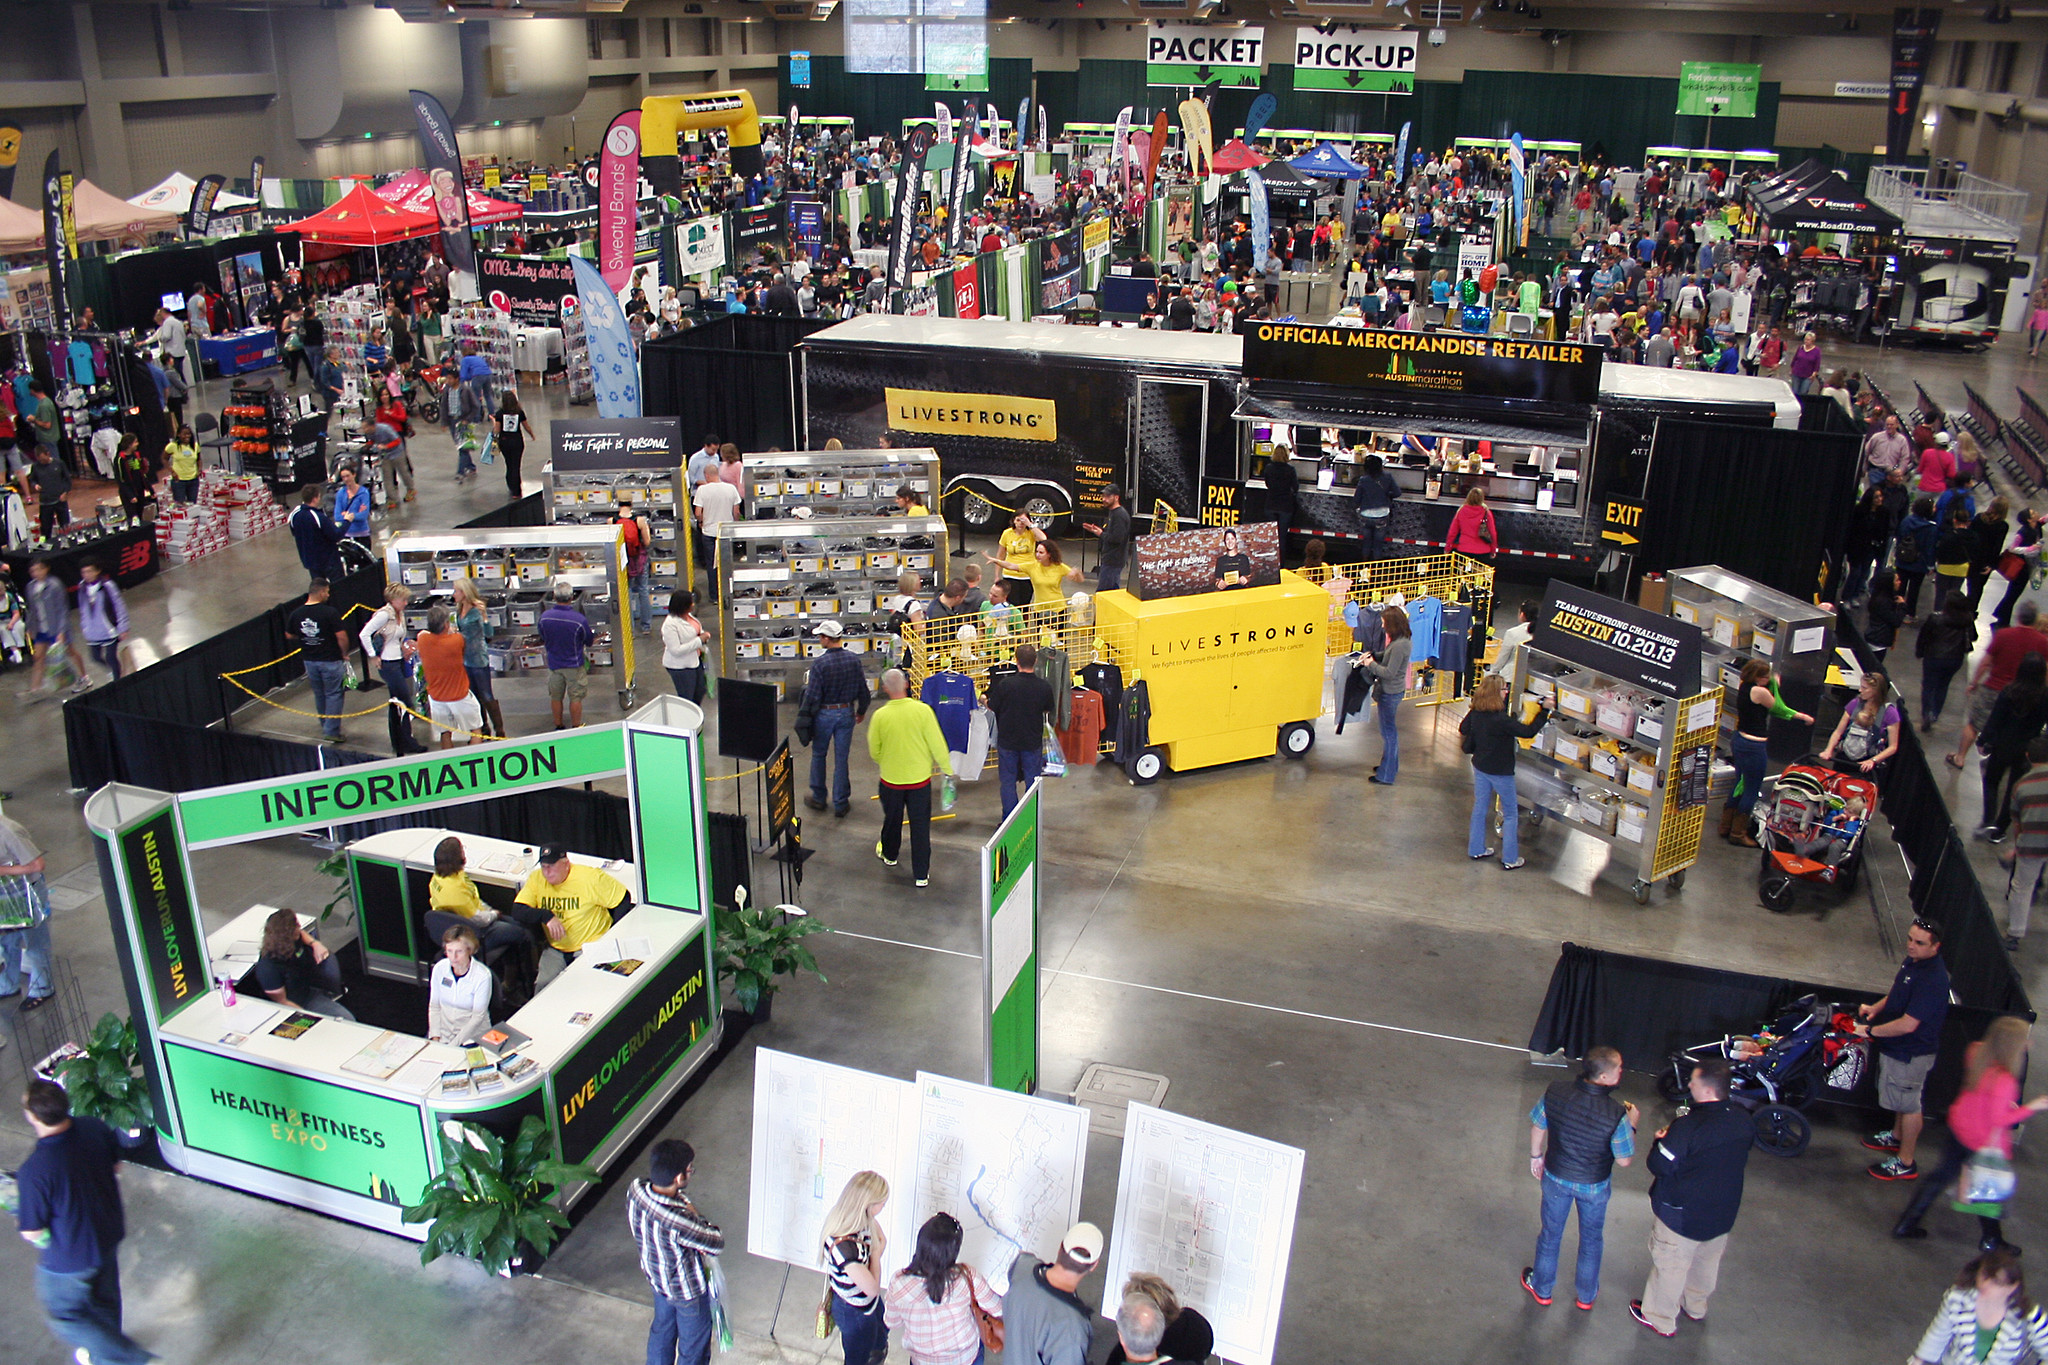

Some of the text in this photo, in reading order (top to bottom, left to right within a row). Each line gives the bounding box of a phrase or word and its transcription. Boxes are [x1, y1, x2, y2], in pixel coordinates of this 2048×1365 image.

[1149, 37, 1261, 63] PACKET
[1298, 42, 1415, 69] PICK-UP
[608, 163, 627, 270] Bands Sweaty
[1796, 221, 1876, 232] www.RoadID.com
[1258, 324, 1583, 363] OFFICIAL MERCHANDISE RETAILER
[901, 405, 1038, 428] LIVESTRONG
[1307, 405, 1398, 417] LIVESTRONG
[1075, 464, 1113, 475] CHECK OUT
[1207, 485, 1235, 506] PAY
[1202, 506, 1240, 527] HERE
[1605, 502, 1643, 528] EXIT
[1550, 610, 1615, 642] AUSTIN
[1611, 630, 1677, 664] 10.20.13
[1555, 600, 1580, 613] TEAM
[1578, 607, 1629, 631] LIVESTRONG
[1628, 624, 1680, 648] CHALLENGE
[1151, 623, 1314, 656] LIVESTRONG
[1161, 660, 1175, 669] fight
[1183, 657, 1206, 666] improve
[1216, 652, 1228, 660] lives
[1237, 649, 1255, 660] people
[1255, 646, 1278, 655] affected
[1279, 646, 1286, 654] by
[260, 745, 558, 823] INFORMATION
[541, 896, 580, 910] AUSTIN
[271, 1123, 327, 1152] EXPO
